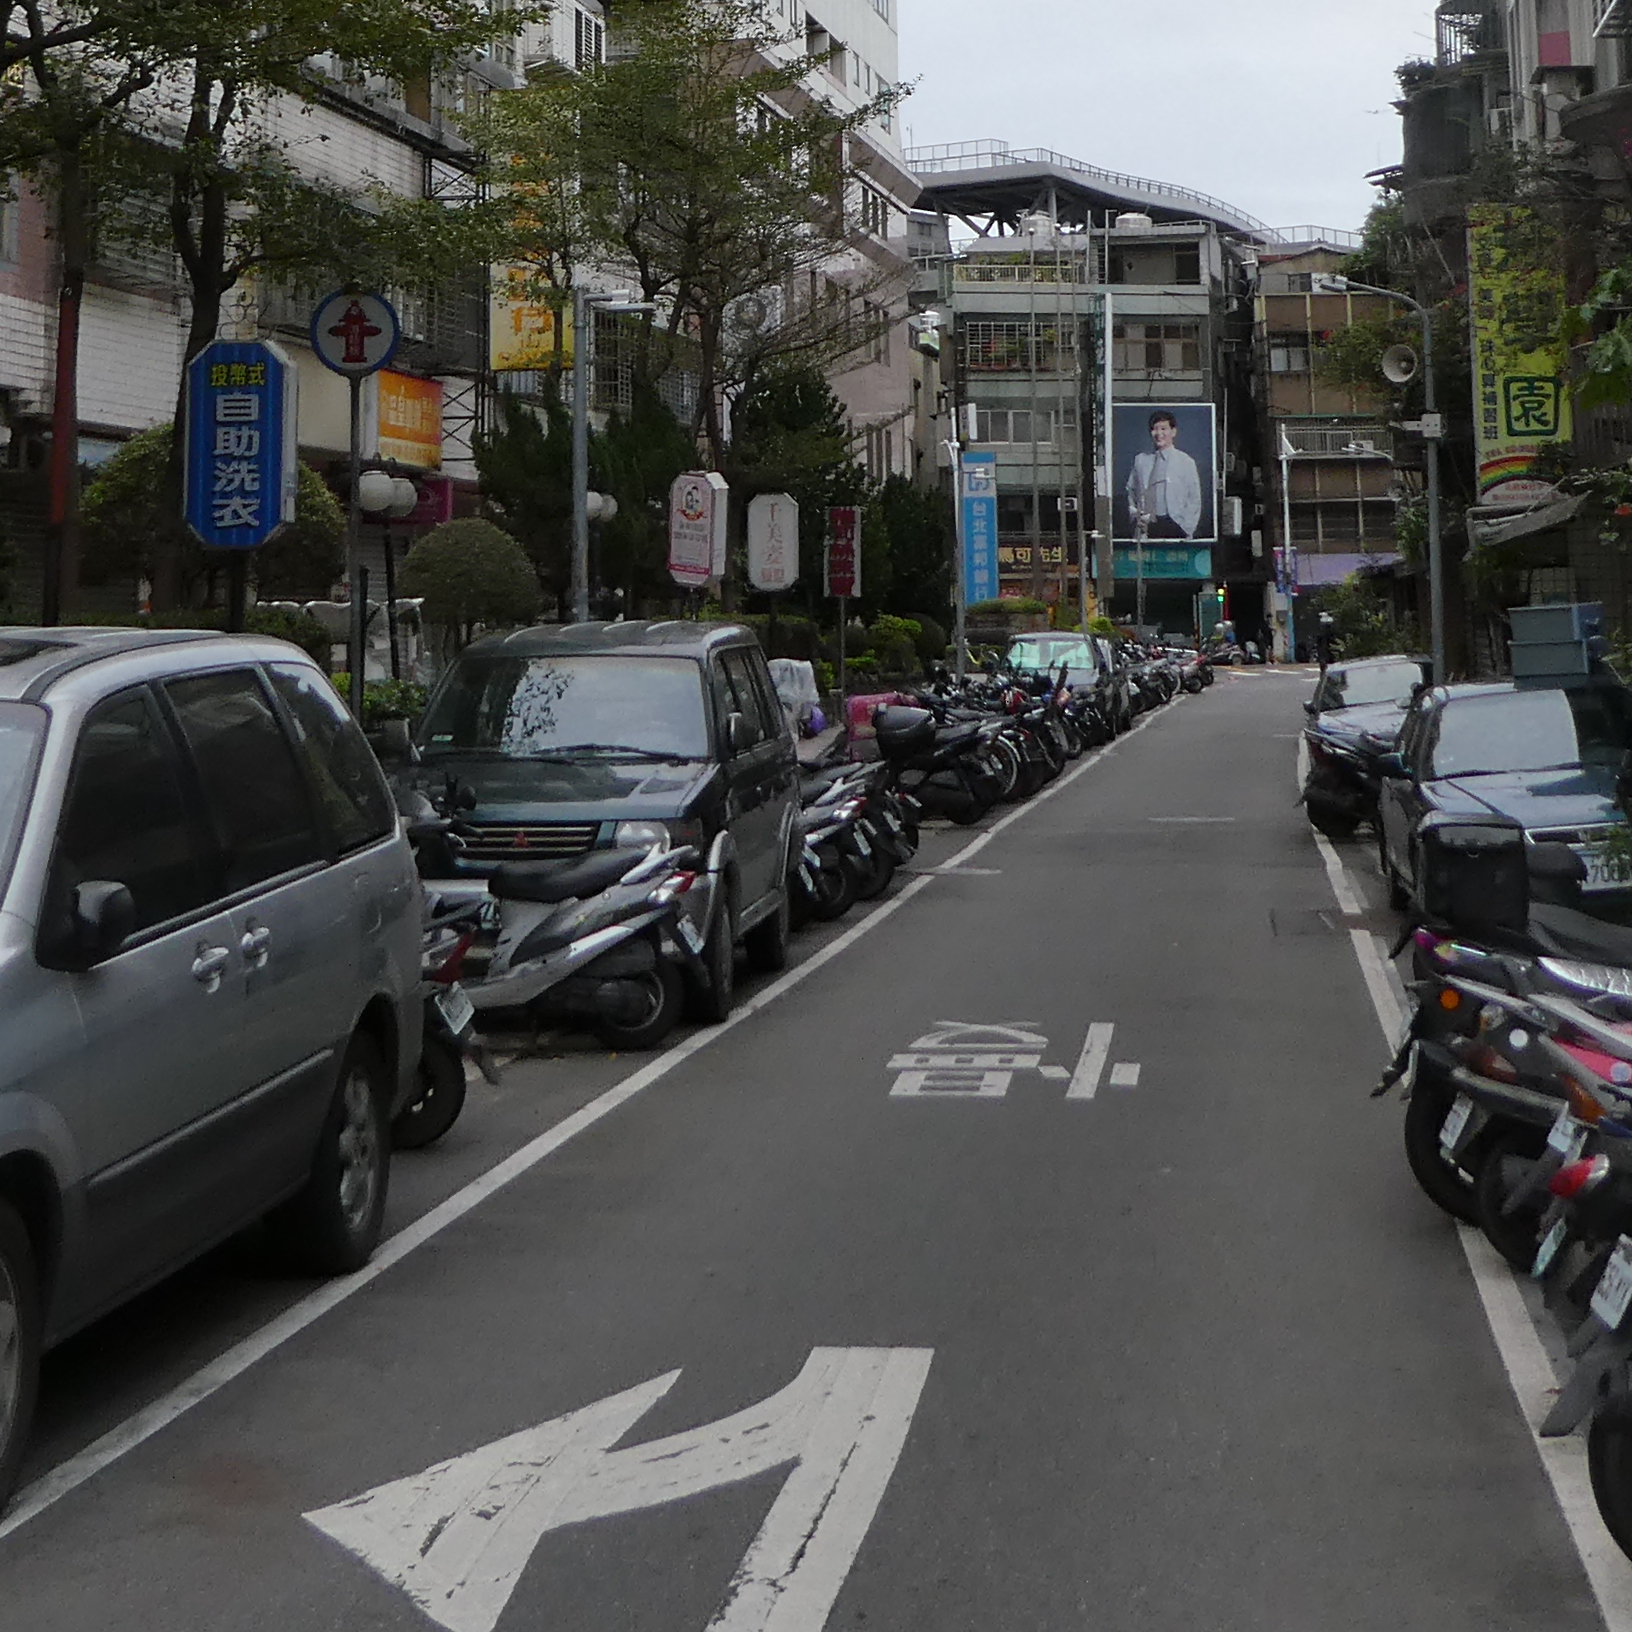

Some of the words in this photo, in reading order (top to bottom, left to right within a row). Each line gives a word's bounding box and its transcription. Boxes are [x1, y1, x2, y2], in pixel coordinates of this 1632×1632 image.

[211, 361, 265, 386] 投幣式
[212, 392, 261, 528] 自助洗衣
[885, 1019, 1142, 1099] 慢
